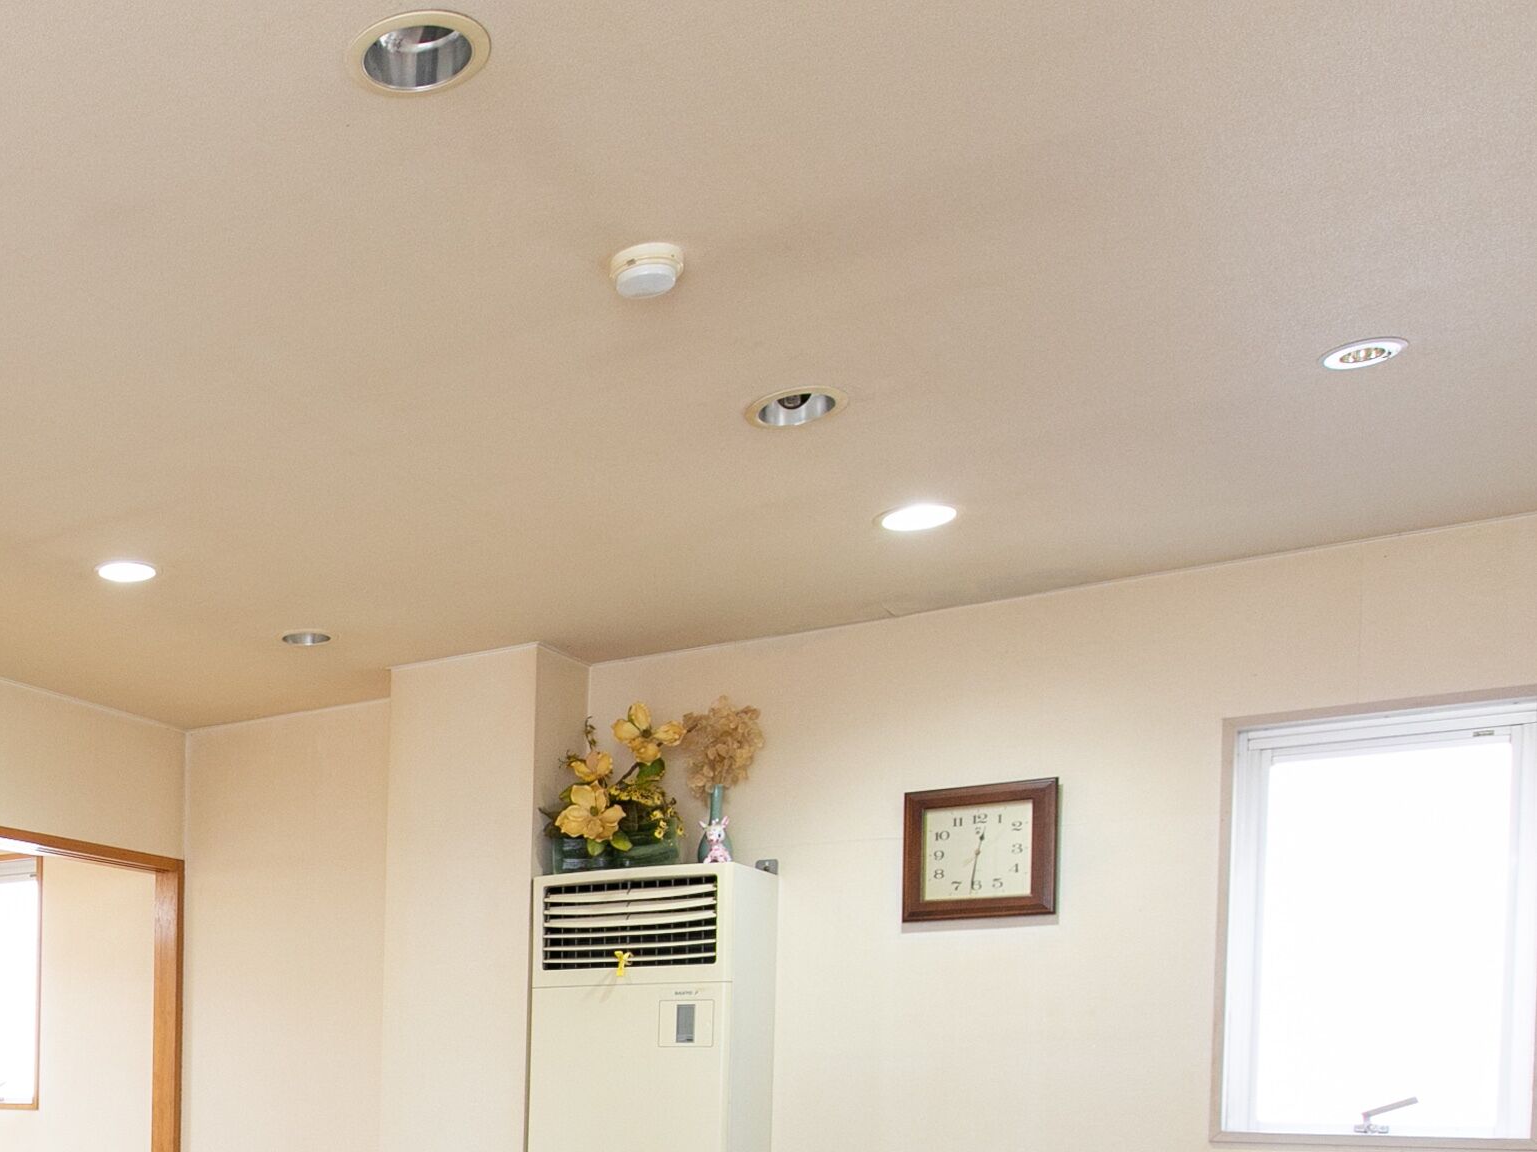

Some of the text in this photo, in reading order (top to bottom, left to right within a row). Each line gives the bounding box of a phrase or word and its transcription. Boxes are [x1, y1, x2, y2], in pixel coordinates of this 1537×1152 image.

[972, 813, 988, 824] 12
[997, 814, 1003, 824] 1
[1011, 821, 1023, 831] 2
[934, 830, 950, 841] 10
[1011, 843, 1023, 853] 3
[933, 850, 945, 861] 9
[1009, 863, 1019, 873] 4
[933, 869, 945, 879] 8
[951, 880, 963, 891] 7
[991, 878, 1003, 888] 5
